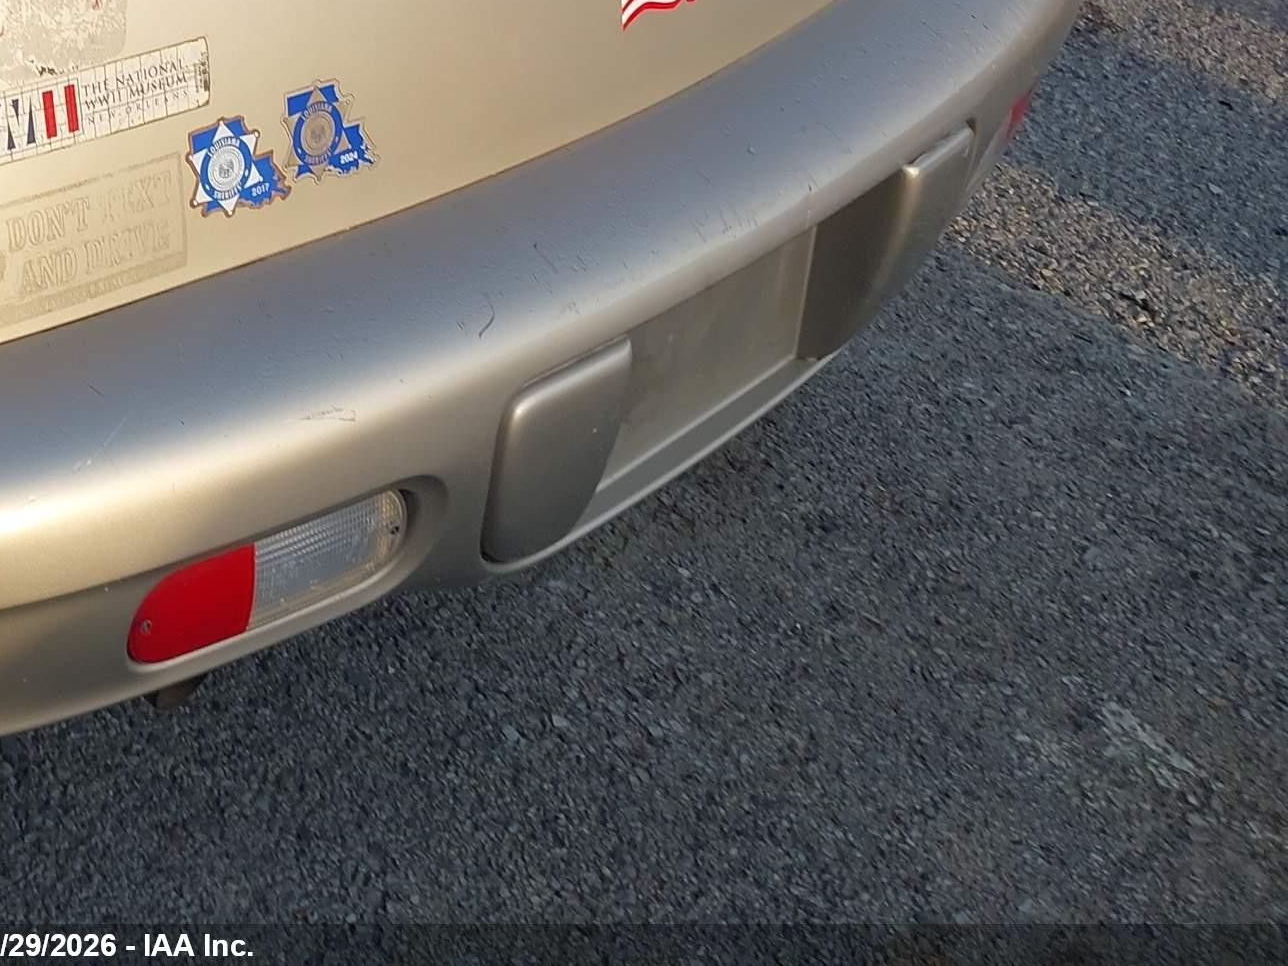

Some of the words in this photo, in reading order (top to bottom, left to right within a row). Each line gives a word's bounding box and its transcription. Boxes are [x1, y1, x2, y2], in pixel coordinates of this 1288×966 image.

[84, 79, 111, 97] THE
[116, 58, 186, 88] NATIONAL
[85, 90, 122, 111] WWII
[127, 73, 187, 99] MUSEUM
[251, 182, 270, 197] 2017
[5, 196, 91, 252] DON'T
[23, 249, 79, 295] AND
[83, 221, 171, 275] DRIVE
